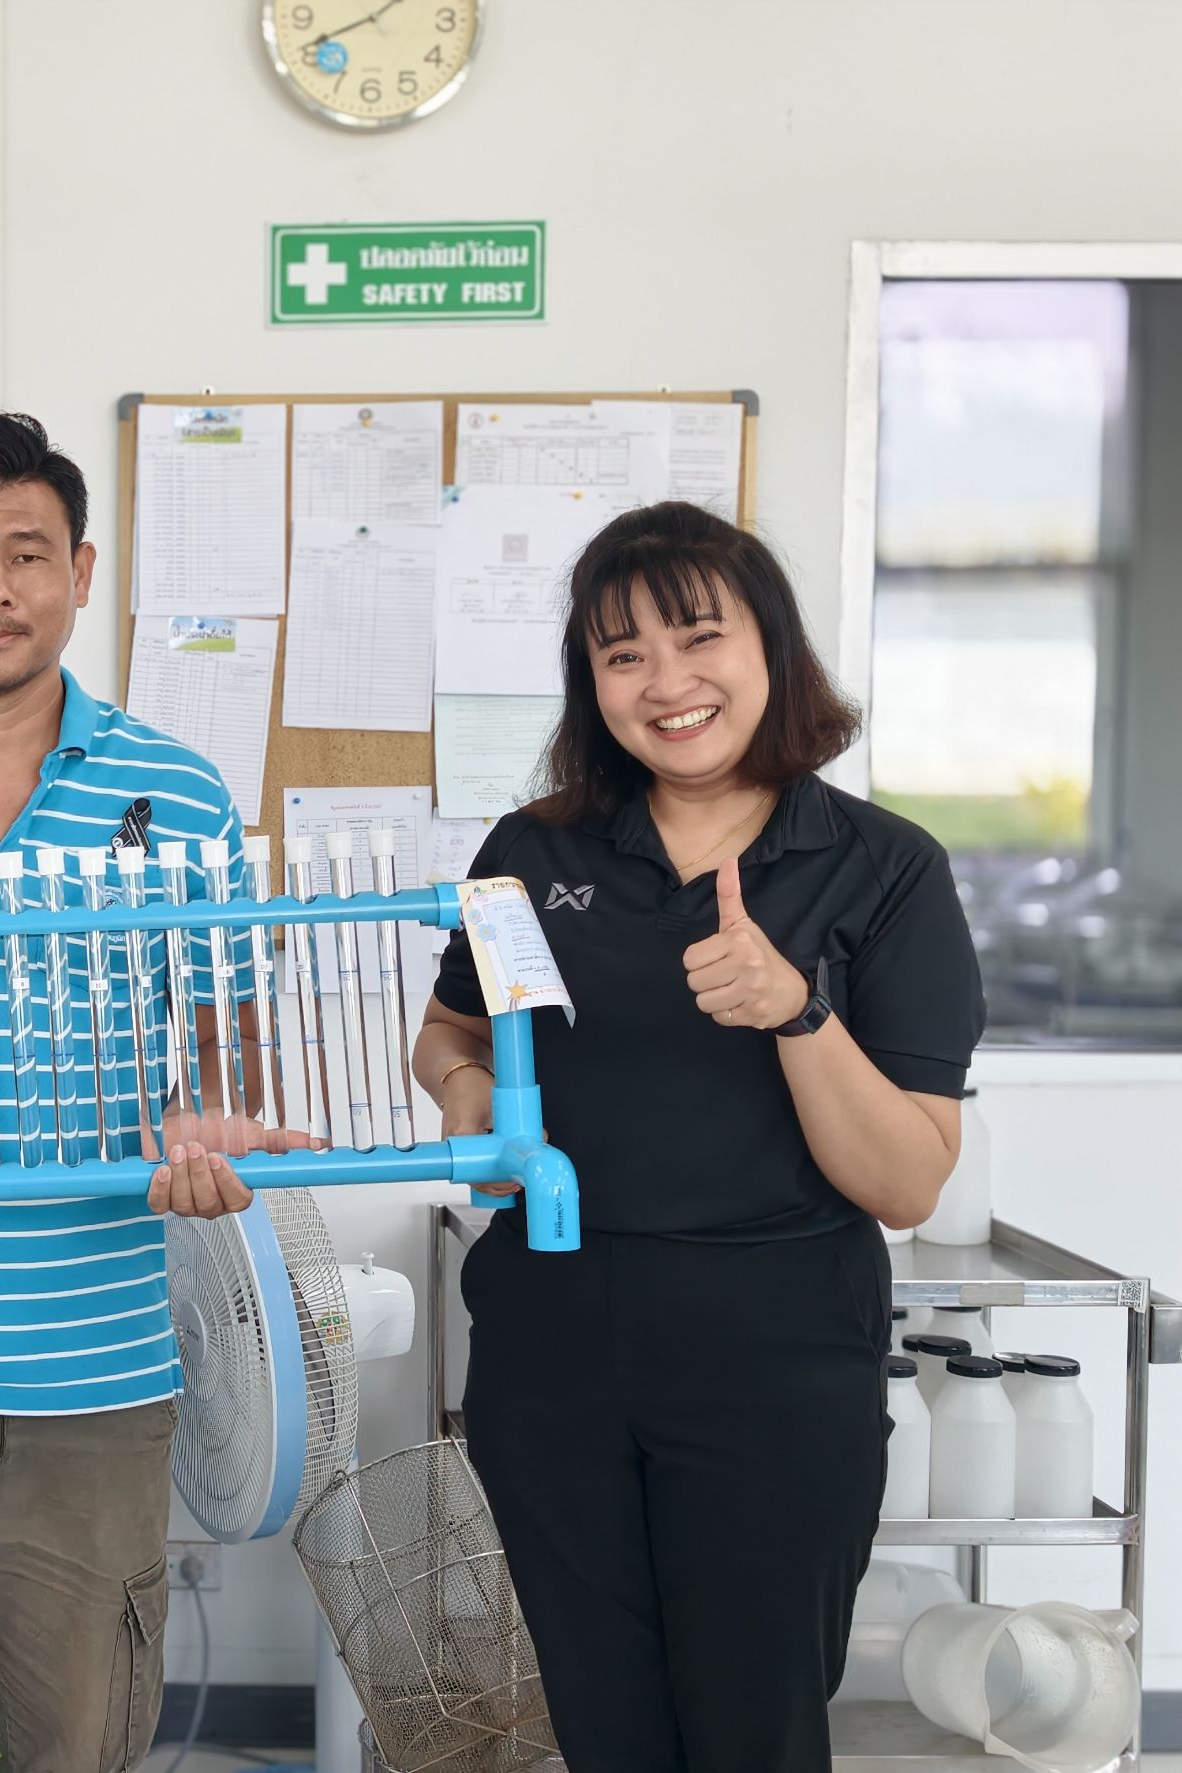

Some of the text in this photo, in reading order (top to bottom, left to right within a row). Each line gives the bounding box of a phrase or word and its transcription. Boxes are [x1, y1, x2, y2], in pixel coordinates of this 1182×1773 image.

[291, 5, 314, 31] 9
[434, 8, 457, 32] 3
[423, 44, 444, 68] 4
[359, 78, 382, 103] 6
[396, 71, 418, 96] 5
[361, 281, 526, 305] SAFETY FIRST
